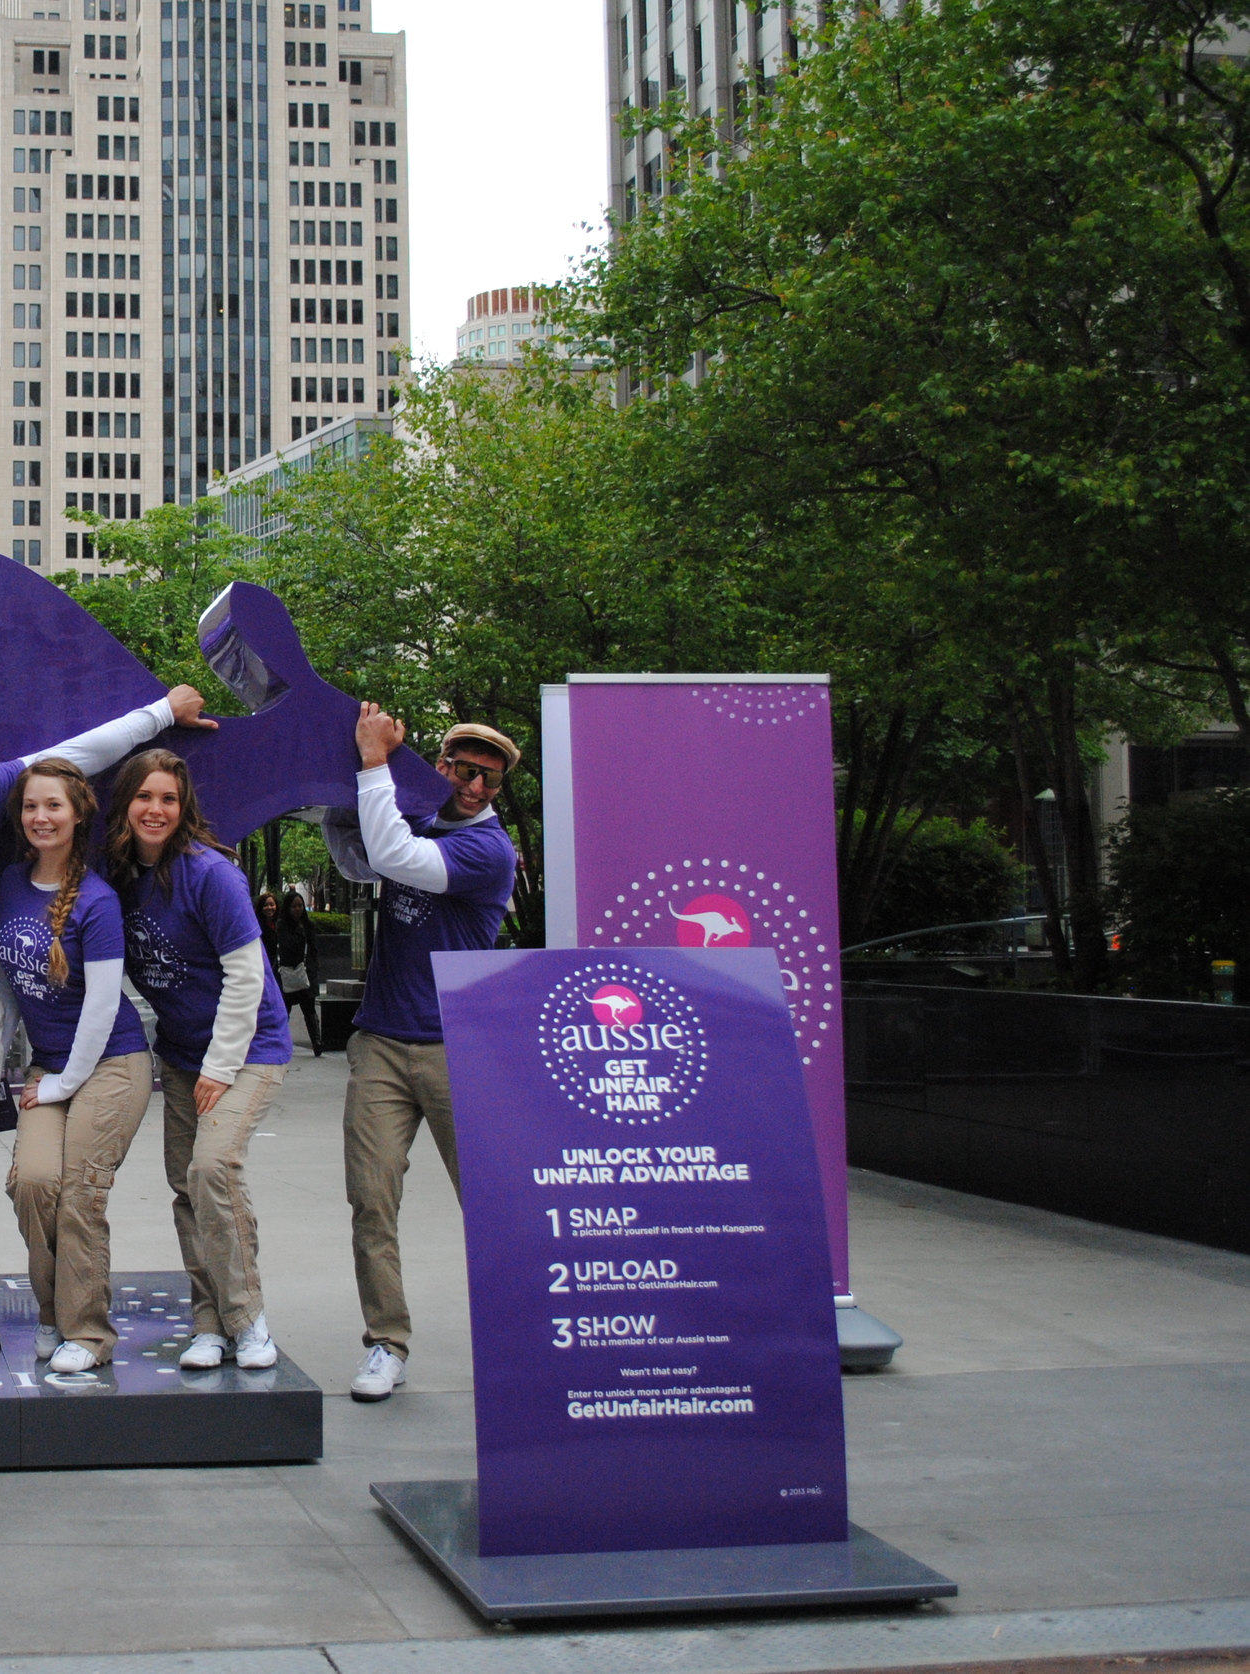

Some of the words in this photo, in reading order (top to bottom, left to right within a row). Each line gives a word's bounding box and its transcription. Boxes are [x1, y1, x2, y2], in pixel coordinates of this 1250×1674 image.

[398, 894, 414, 906] GET
[0, 945, 50, 976] aussie
[16, 970, 35, 980] GET
[147, 978, 170, 988] HAIR
[560, 1023, 684, 1052] aussie
[604, 1059, 648, 1076] GET
[588, 1076, 672, 1094] UNFAIR
[605, 1094, 661, 1112] HAIR
[562, 1147, 652, 1166] UNLOCK
[655, 1146, 717, 1164] YOUR
[533, 1166, 614, 1185] UNFAIR
[619, 1163, 750, 1184] ADVANTAGE
[545, 1208, 560, 1237] 1
[569, 1207, 637, 1228] SNAP
[579, 1228, 611, 1237] picture
[613, 1227, 622, 1235] of
[624, 1226, 660, 1236] yourself
[661, 1225, 670, 1234] in
[671, 1225, 693, 1234] front
[694, 1225, 704, 1234] of
[705, 1224, 721, 1233] the
[722, 1224, 765, 1234] Kangaroo
[547, 1262, 570, 1293] 2
[573, 1259, 678, 1282] UPLOAD
[576, 1282, 592, 1292] the
[593, 1281, 625, 1292] picture
[626, 1281, 637, 1290] to
[638, 1279, 718, 1290] GetUnfairHair.com
[551, 1317, 573, 1348] 3
[576, 1314, 656, 1337] SHOW
[580, 1338, 588, 1347] it
[588, 1338, 599, 1347] to
[608, 1336, 645, 1346] member
[647, 1336, 657, 1345] of
[658, 1336, 674, 1345] our
[676, 1335, 705, 1344] Aussie
[706, 1334, 729, 1343] team
[620, 1367, 651, 1377] Wasn't
[652, 1366, 671, 1376] that
[672, 1366, 697, 1376] easy?
[567, 1390, 592, 1399] Enter
[593, 1390, 604, 1398] to
[605, 1388, 635, 1398] unlock
[637, 1388, 660, 1397] more
[662, 1386, 688, 1396] unfair
[689, 1385, 740, 1396] advantages
[741, 1384, 751, 1393] at
[567, 1397, 754, 1420] GetUnfairHair.com
